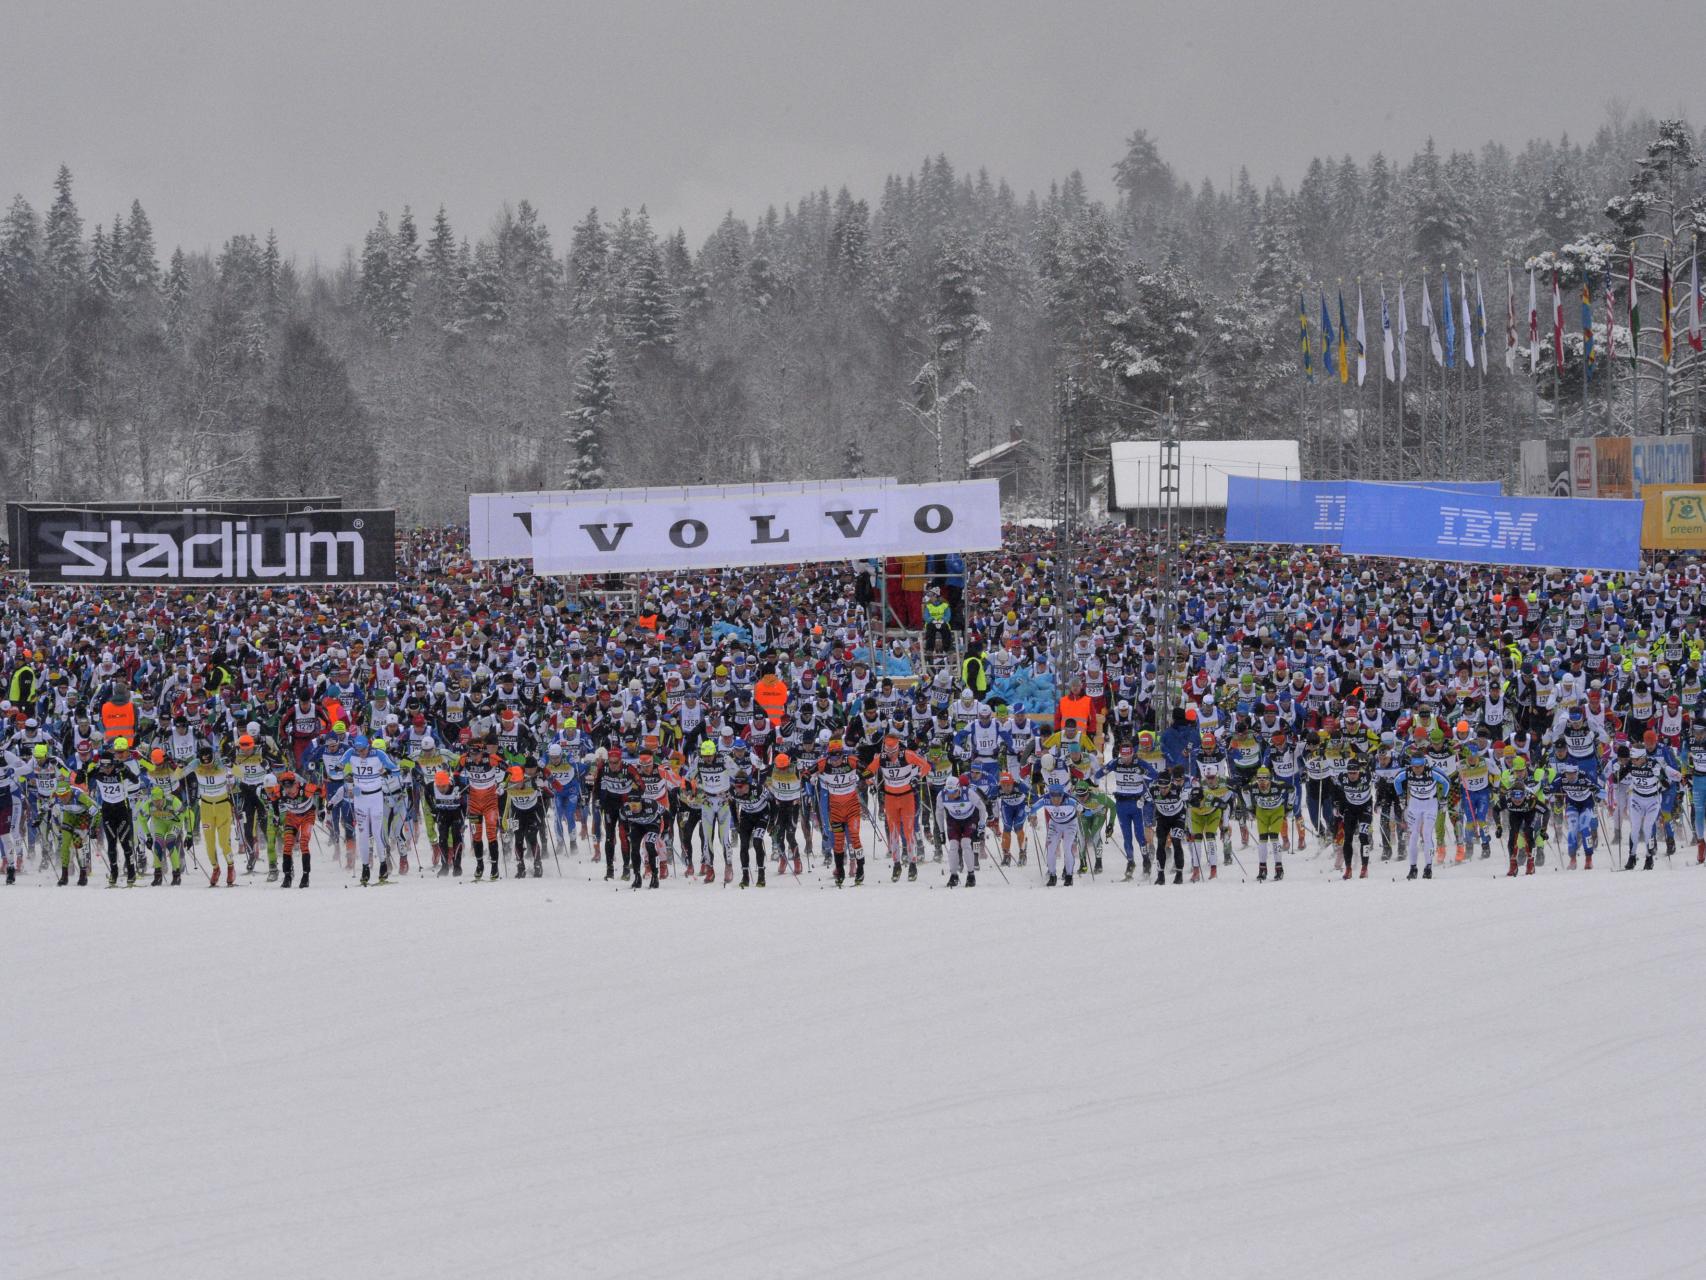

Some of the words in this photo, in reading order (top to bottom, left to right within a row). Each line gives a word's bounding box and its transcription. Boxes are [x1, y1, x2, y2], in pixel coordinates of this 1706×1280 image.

[579, 504, 954, 552] VOLVO
[1437, 506, 1538, 551] IBM
[1670, 524, 1703, 534] preem
[60, 519, 364, 577] stadium
[1570, 737, 1586, 746] 187
[1333, 759, 1346, 768] 60
[244, 765, 257, 774] 55
[356, 766, 373, 775] 179
[888, 768, 900, 778] 97
[205, 776, 215, 785] 10
[703, 775, 721, 783] 242
[833, 774, 846, 784] 47
[1636, 778, 1648, 786] 25
[103, 785, 120, 795] 224
[778, 782, 791, 790] 191
